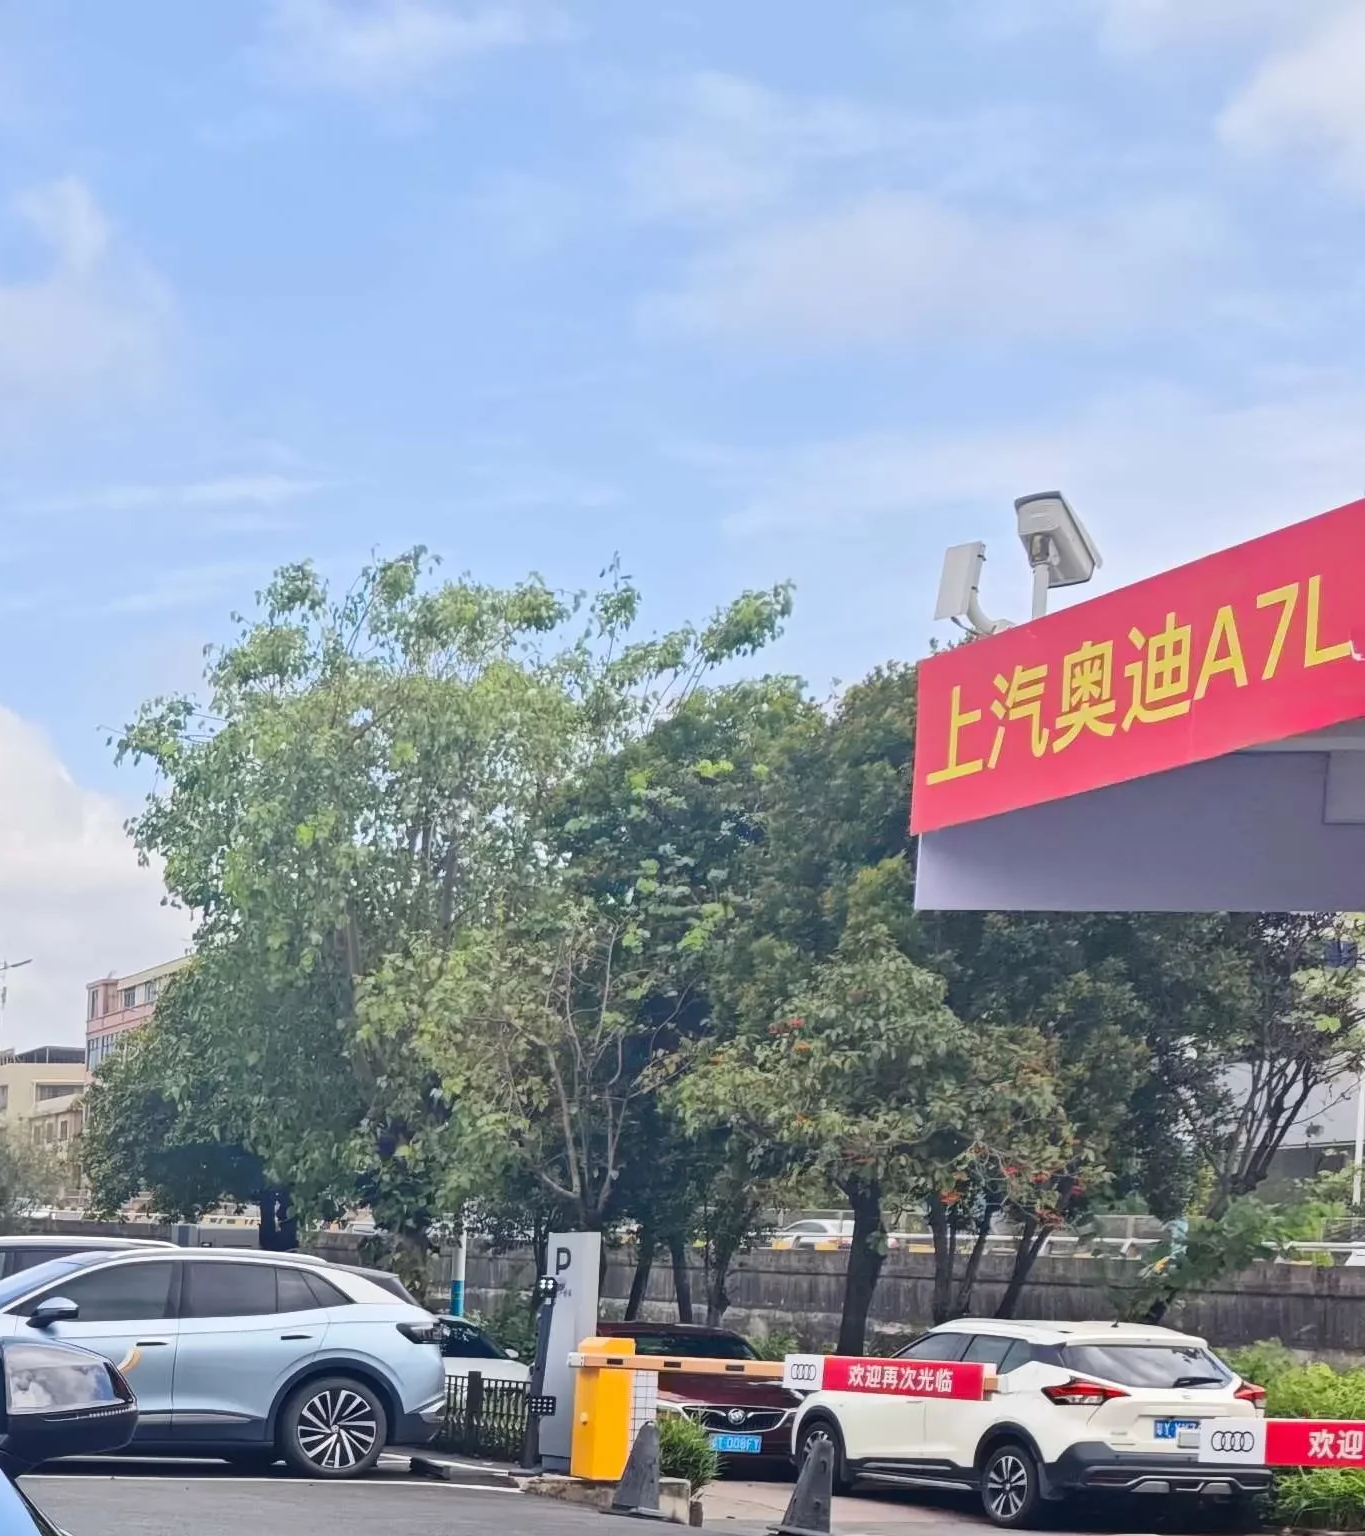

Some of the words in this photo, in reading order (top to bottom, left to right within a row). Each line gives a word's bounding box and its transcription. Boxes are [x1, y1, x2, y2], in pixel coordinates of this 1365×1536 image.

[926, 575, 1351, 786] 上汽奥迪A7L
[556, 1247, 571, 1275] P
[847, 1363, 954, 1393] 欢迎再次光临
[1307, 1429, 1365, 1461] 欢迎
